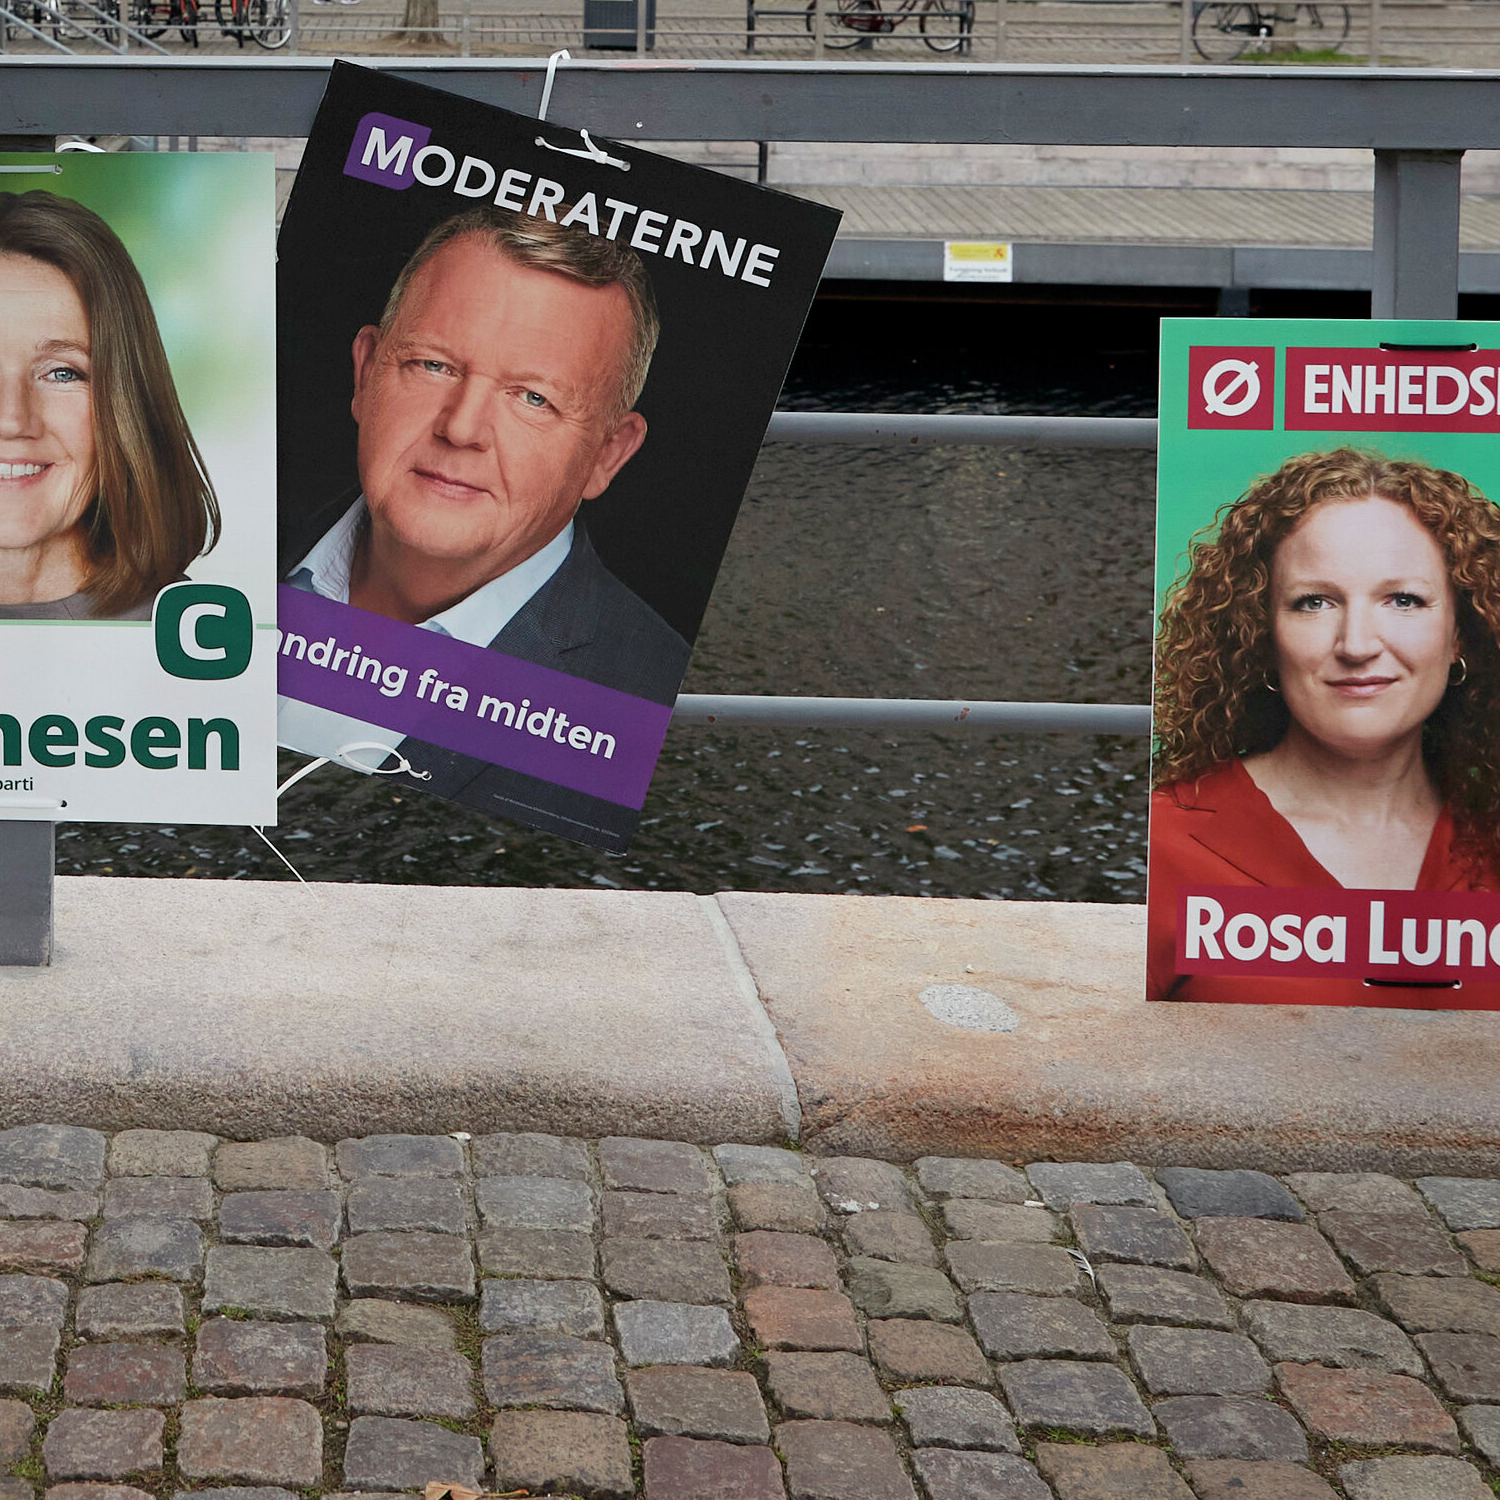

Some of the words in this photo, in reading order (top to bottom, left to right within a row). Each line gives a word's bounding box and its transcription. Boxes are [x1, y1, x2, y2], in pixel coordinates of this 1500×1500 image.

[361, 126, 781, 289] MODERATERNE
[1202, 358, 1261, 417] Ø
[1304, 364, 1500, 416] ENHEDS
[179, 603, 228, 661] C
[277, 628, 409, 698] ndring
[416, 668, 470, 713] fra
[476, 694, 617, 760] midten
[1185, 896, 1347, 963] Rosa
